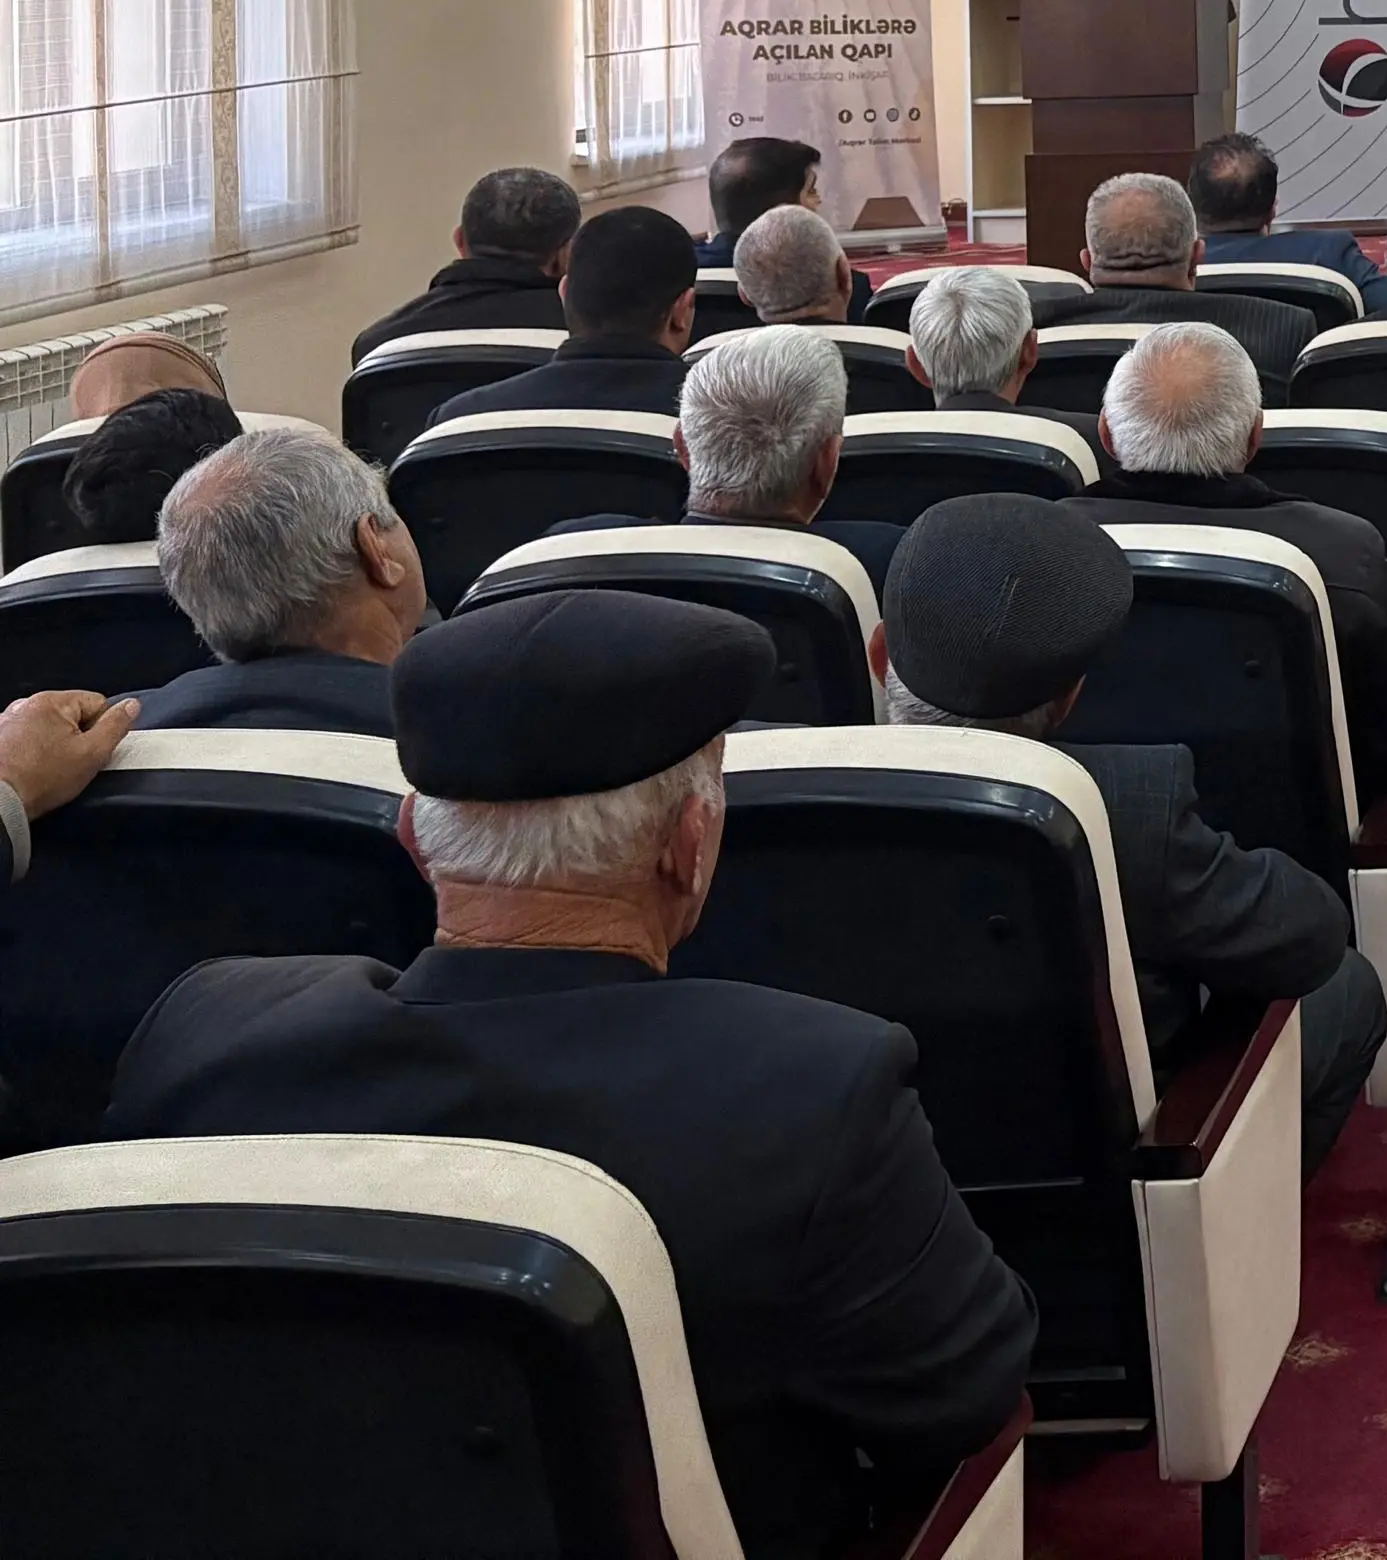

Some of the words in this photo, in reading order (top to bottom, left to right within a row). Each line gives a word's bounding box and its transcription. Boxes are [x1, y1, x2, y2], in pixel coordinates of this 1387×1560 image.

[720, 19, 804, 39] AQRAR
[810, 14, 917, 36] BİLİKLƏRƏ
[752, 44, 834, 65] AÇILAN
[841, 43, 893, 62] QAPI
